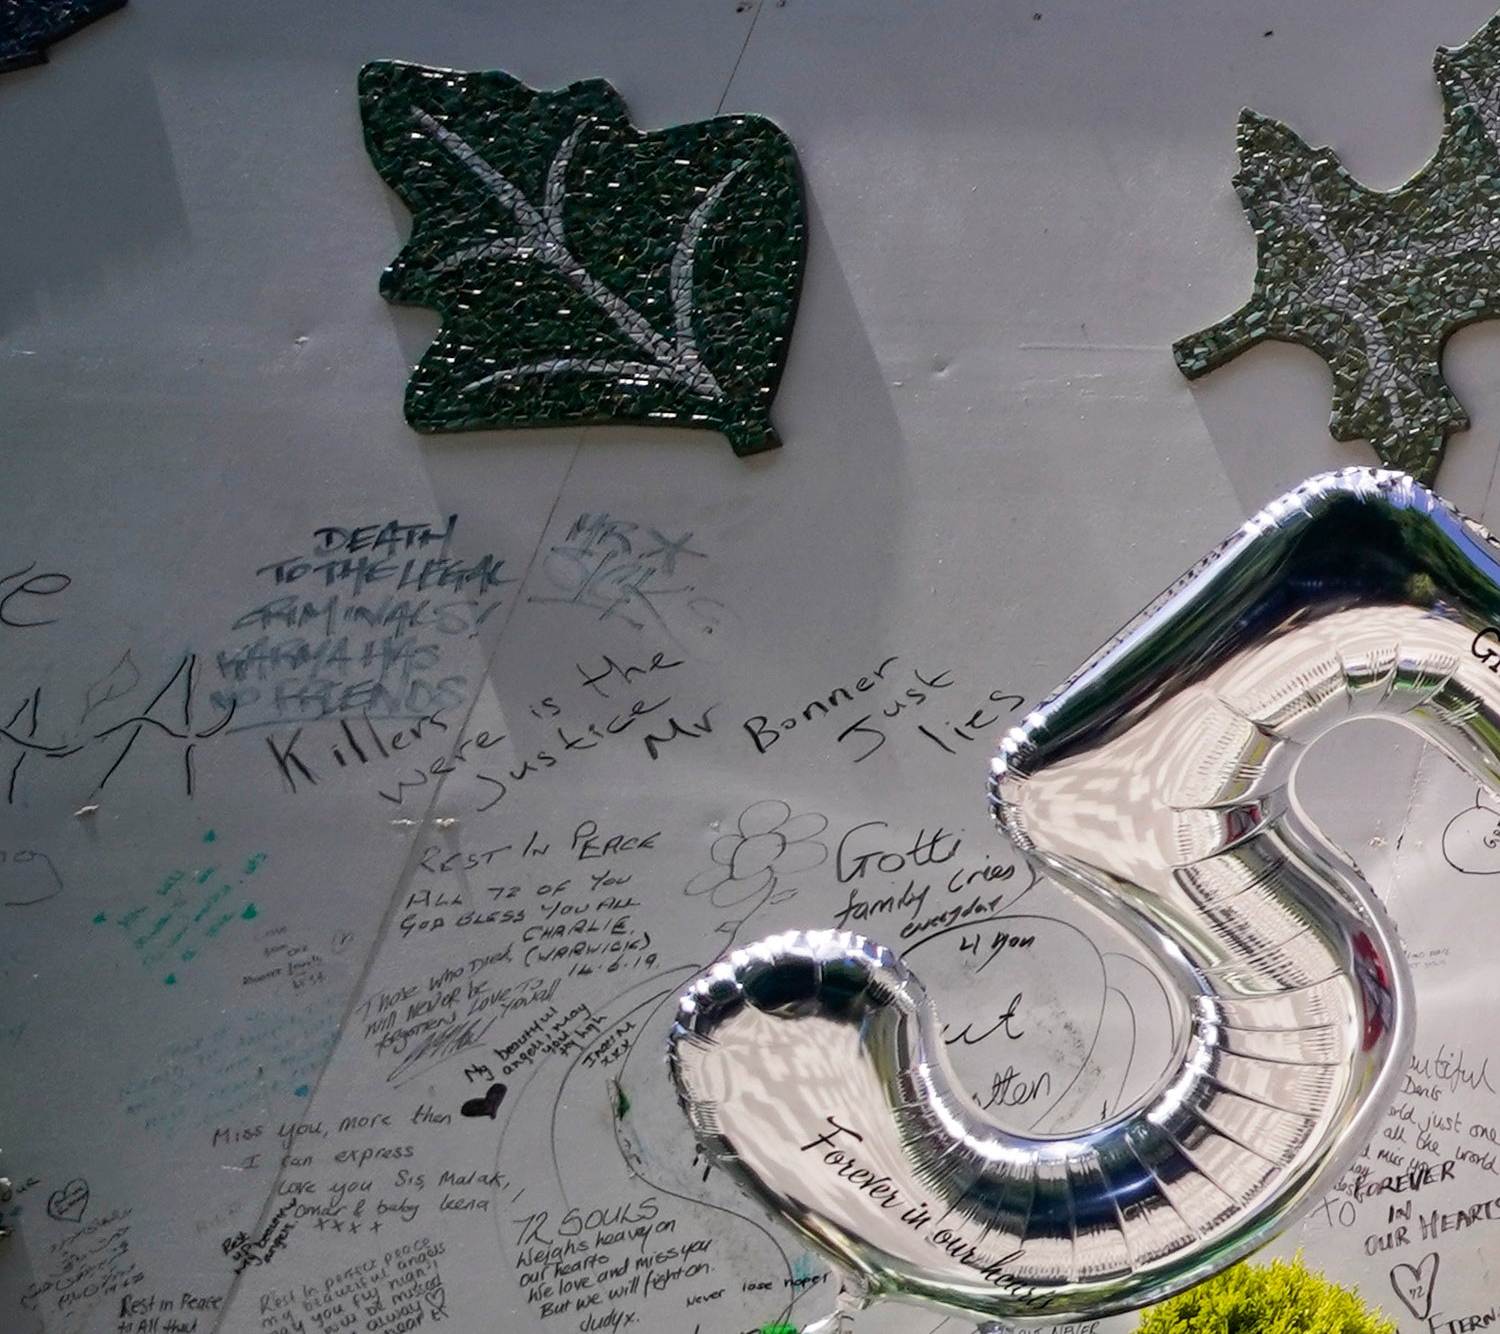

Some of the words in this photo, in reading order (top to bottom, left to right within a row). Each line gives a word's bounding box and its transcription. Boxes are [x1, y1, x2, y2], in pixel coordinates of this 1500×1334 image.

[513, 1211, 553, 1245] 72
[559, 1197, 658, 1236] SOULS
[801, 1116, 903, 1208] Forever
[901, 1202, 930, 1230] in
[932, 1229, 983, 1265] our
